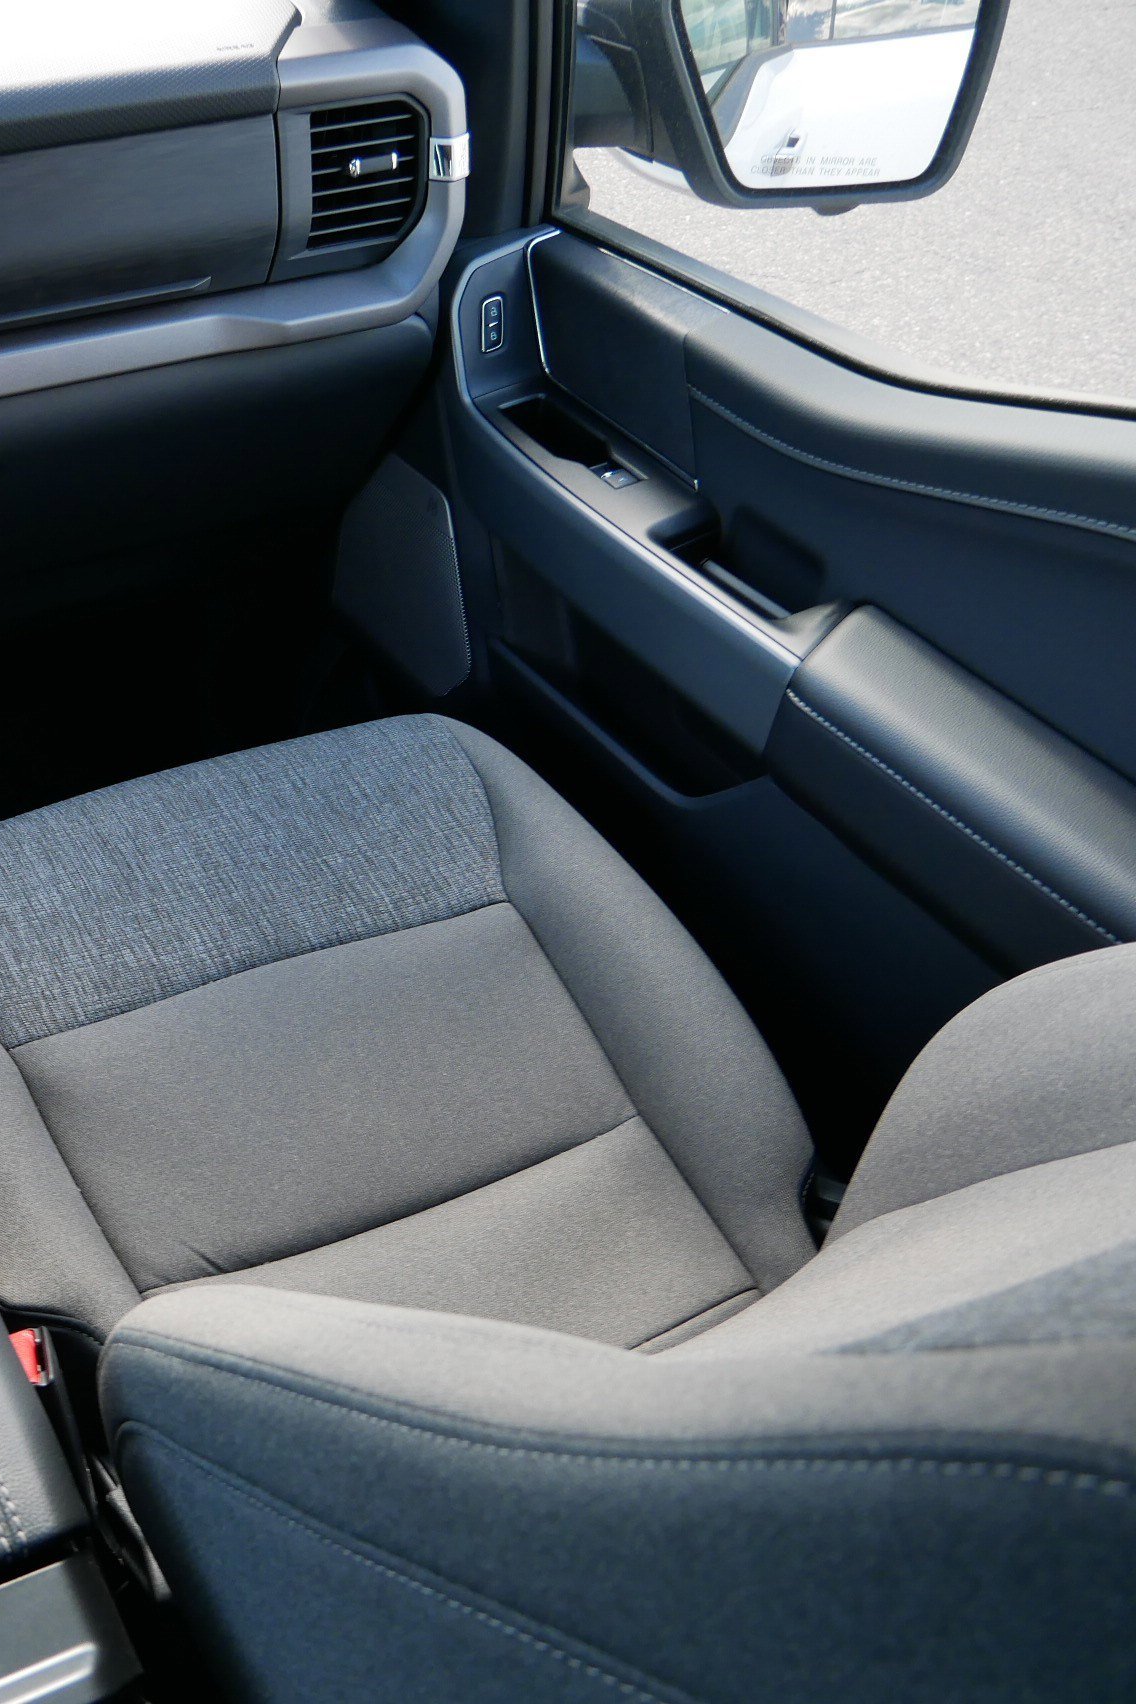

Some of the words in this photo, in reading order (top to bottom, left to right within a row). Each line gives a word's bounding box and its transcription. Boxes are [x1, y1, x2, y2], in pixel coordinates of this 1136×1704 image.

[807, 157, 815, 165] IN
[820, 157, 855, 166] MIRROR
[859, 157, 878, 166] ARE
[791, 167, 814, 176] THAN
[819, 168, 841, 177] THEY
[845, 168, 881, 177] APPEAR
